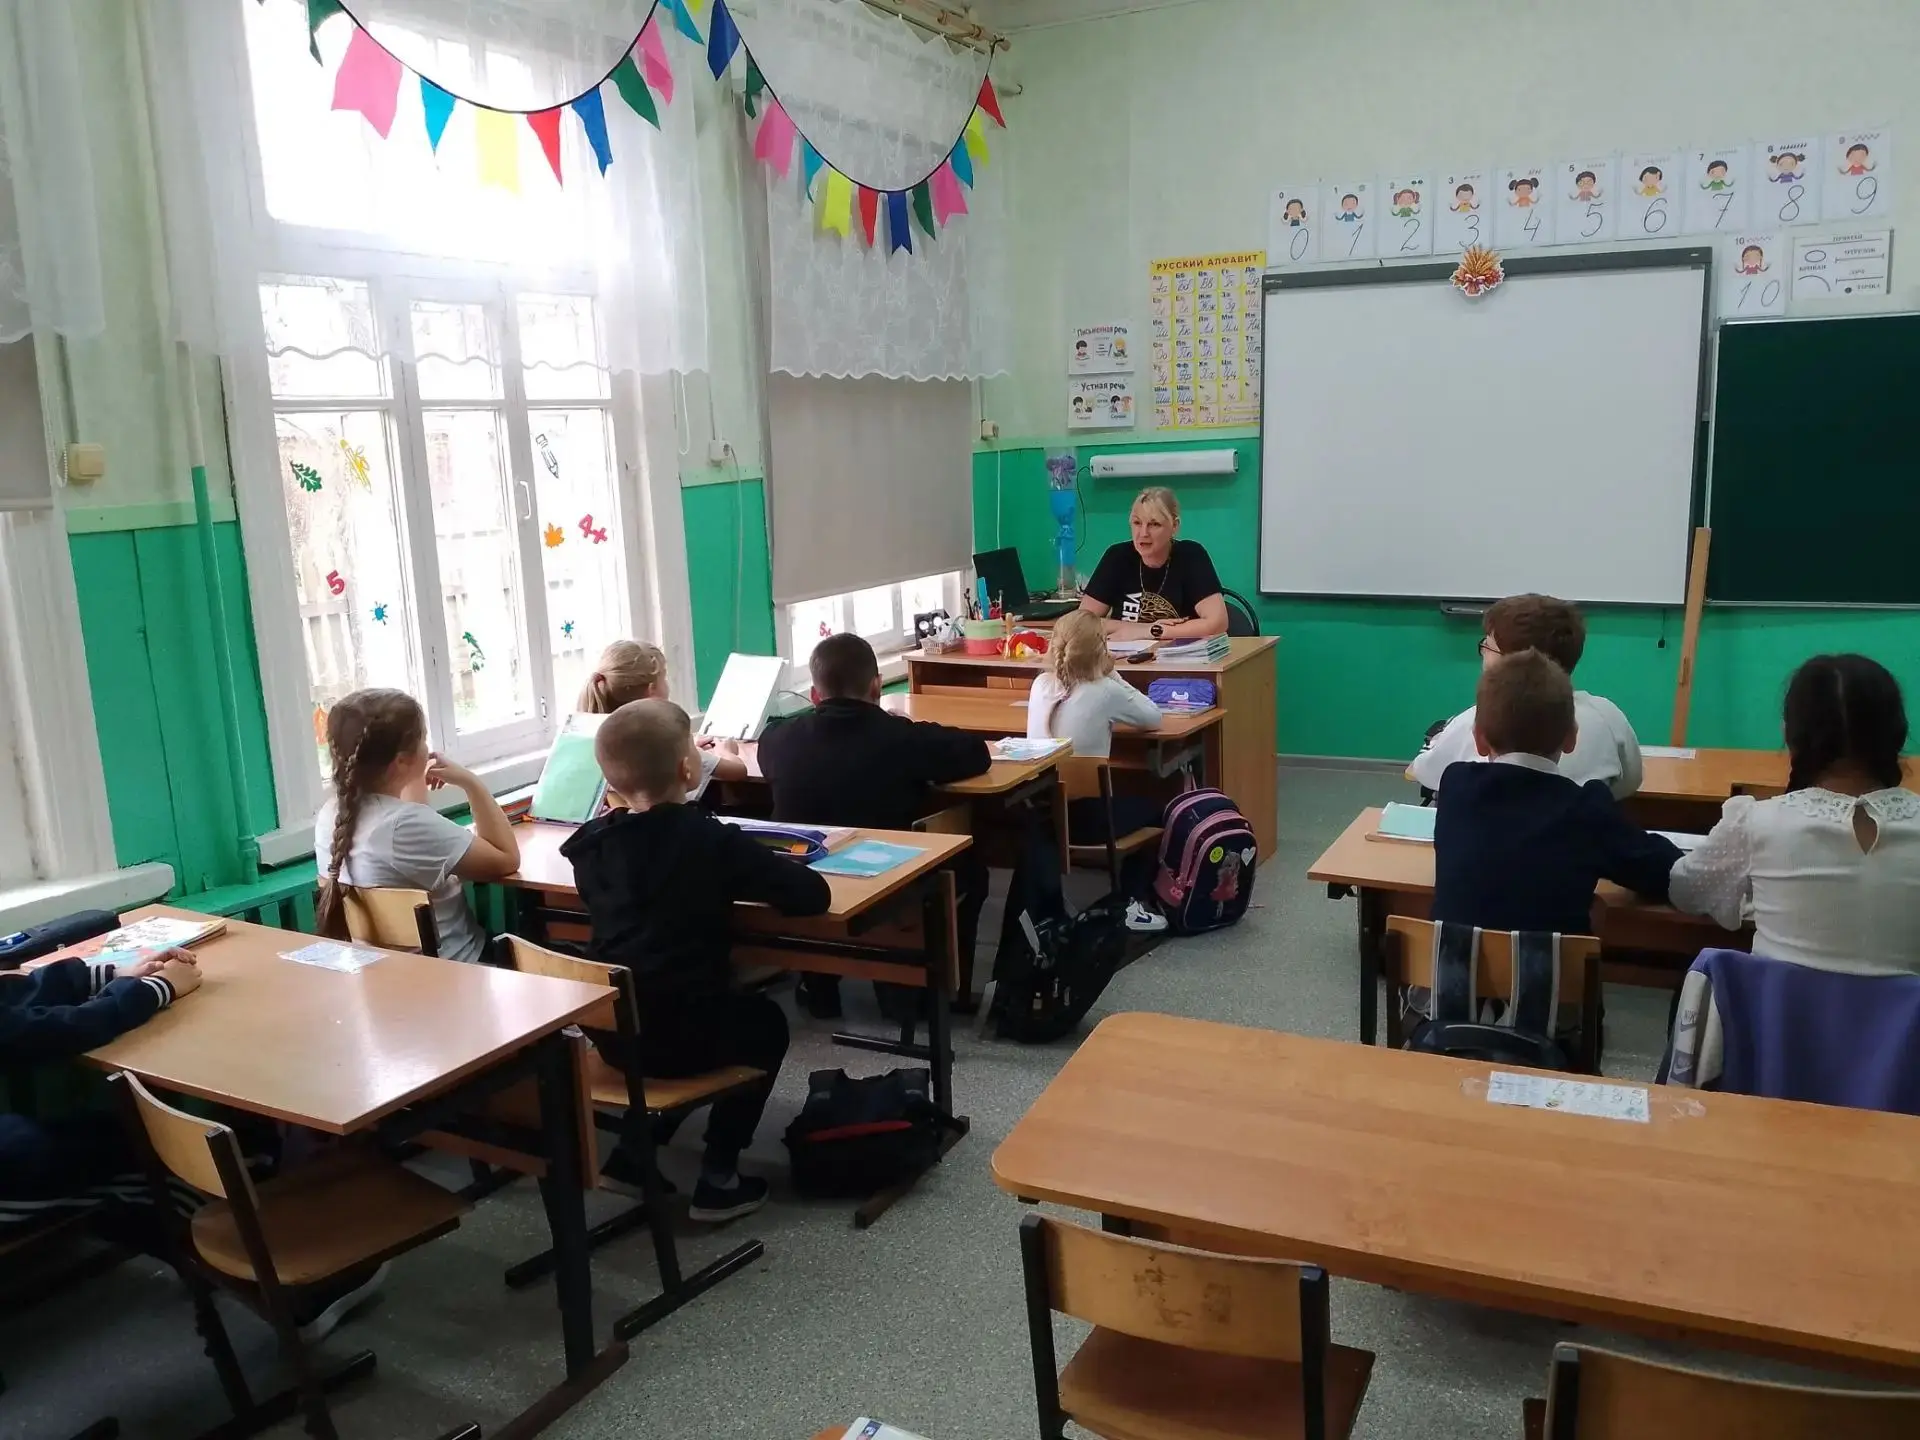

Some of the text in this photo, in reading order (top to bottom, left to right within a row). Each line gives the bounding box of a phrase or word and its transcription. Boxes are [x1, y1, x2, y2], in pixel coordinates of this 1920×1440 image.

[1698, 153, 1704, 161] 7
[1767, 145, 1774, 153] 8
[1448, 176, 1454, 184] 3
[1568, 164, 1575, 172] 5
[1712, 192, 1734, 228] 7
[1778, 184, 1804, 222] 8
[1851, 176, 1878, 214] 9
[1458, 214, 1480, 248] 3
[1524, 209, 1542, 242] 4
[1580, 202, 1604, 238] 5
[1644, 198, 1668, 233] 6
[1290, 228, 1309, 260] 0
[1349, 224, 1364, 256] 1
[1400, 218, 1420, 251] 2
[1735, 236, 1745, 245] 10
[1207, 254, 1258, 267] АЛФАВИТ
[1738, 279, 1780, 309] 10
[1077, 326, 1128, 337] Письменная речь
[1081, 382, 1126, 392] Устная речь
[326, 568, 345, 596] 5
